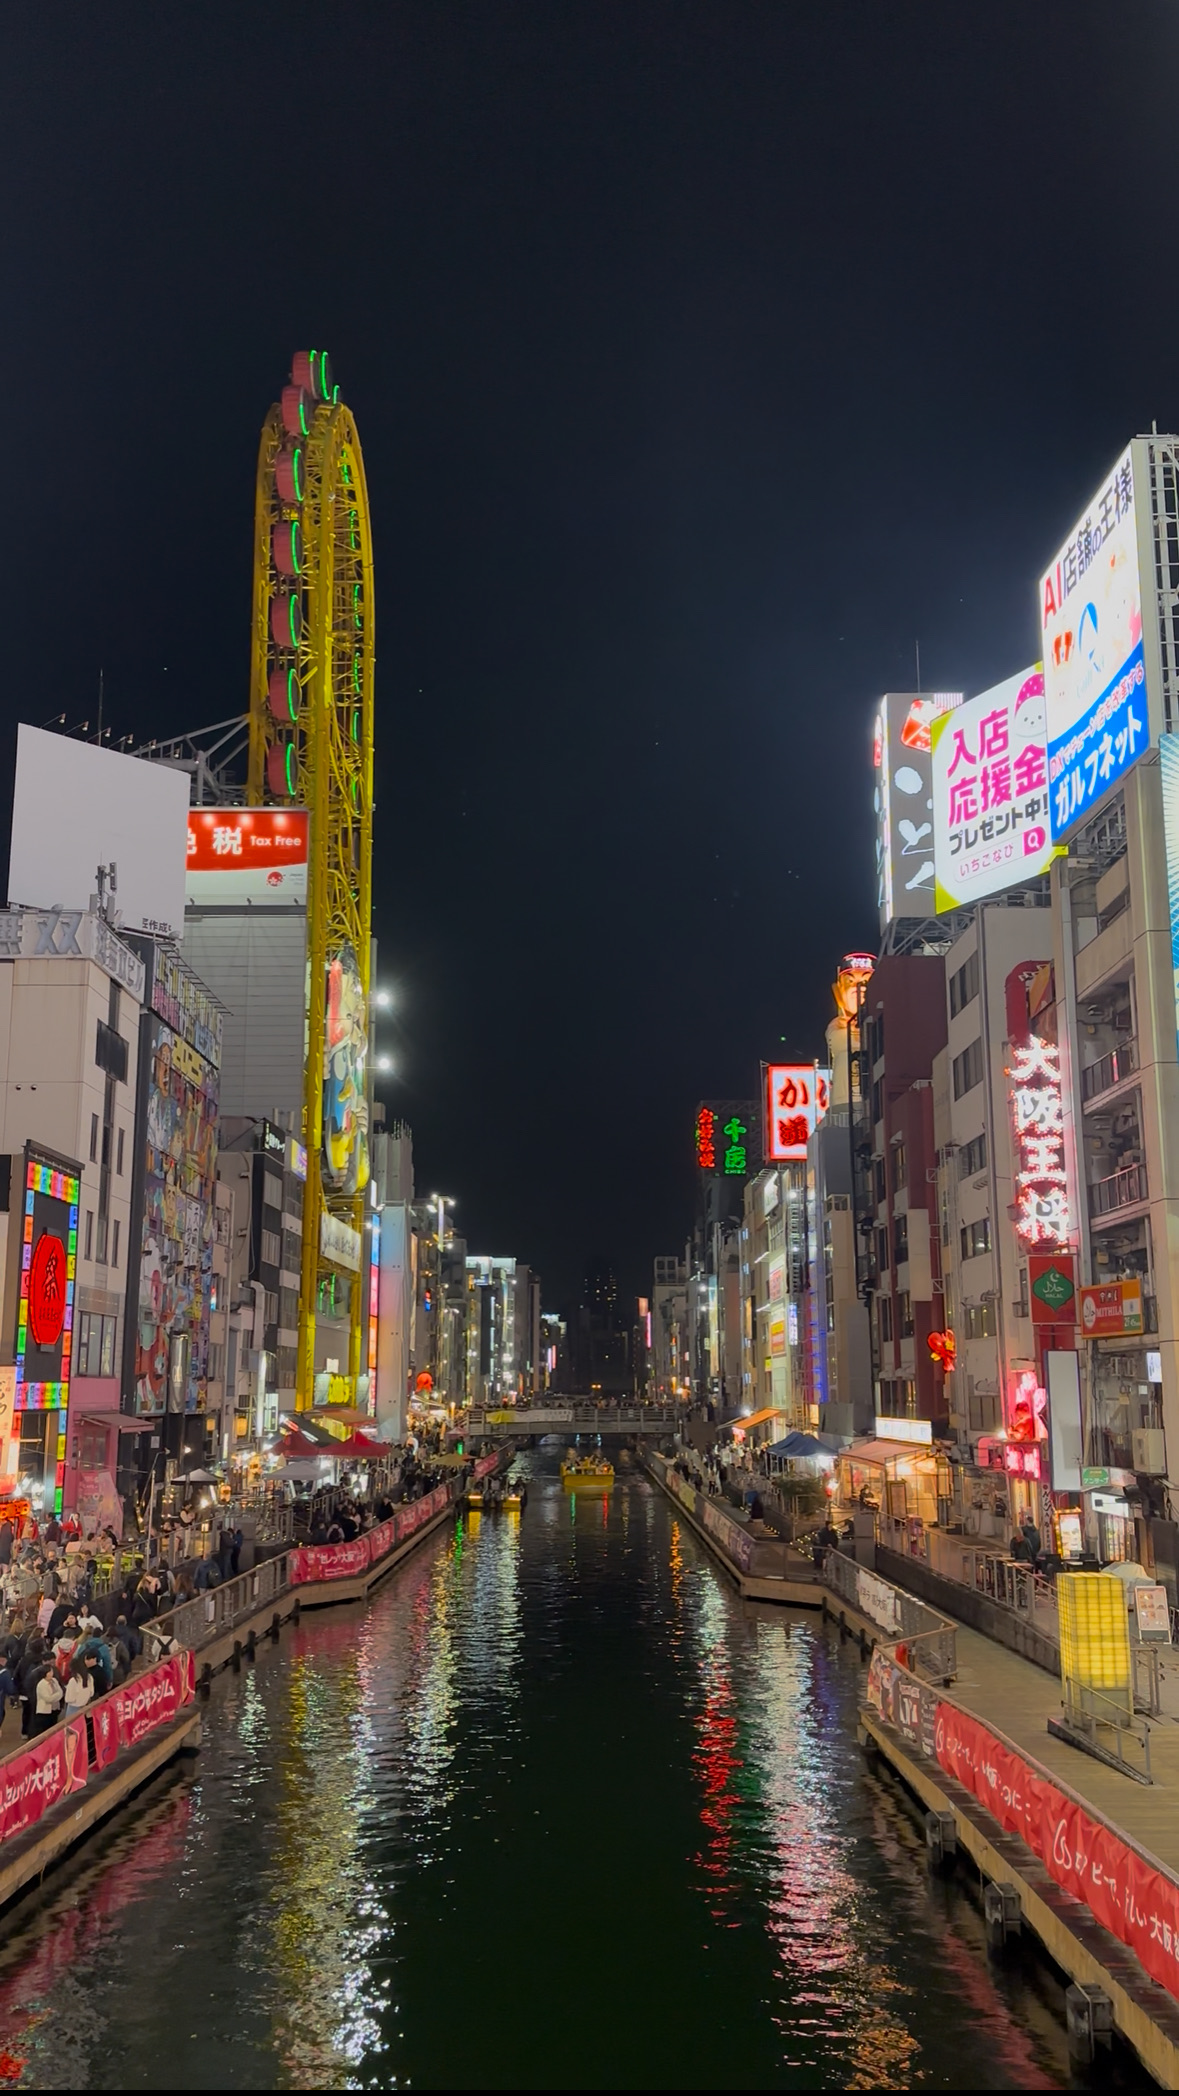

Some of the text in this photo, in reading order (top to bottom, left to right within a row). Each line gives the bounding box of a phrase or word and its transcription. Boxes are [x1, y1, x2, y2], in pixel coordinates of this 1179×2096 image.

[1043, 457, 1133, 630] AI店舗の王様
[947, 706, 1009, 779] 入店
[1055, 704, 1142, 829] ガルフネット
[948, 743, 1047, 829] 応援金
[250, 835, 302, 846] Tax Free
[949, 791, 1049, 856] プレゼント中!
[723, 1117, 747, 1170] 千房
[1008, 1034, 1070, 1245] 大阪王将
[1042, 1281, 1064, 1293] حلال
[1096, 1305, 1123, 1318] MITHILA
